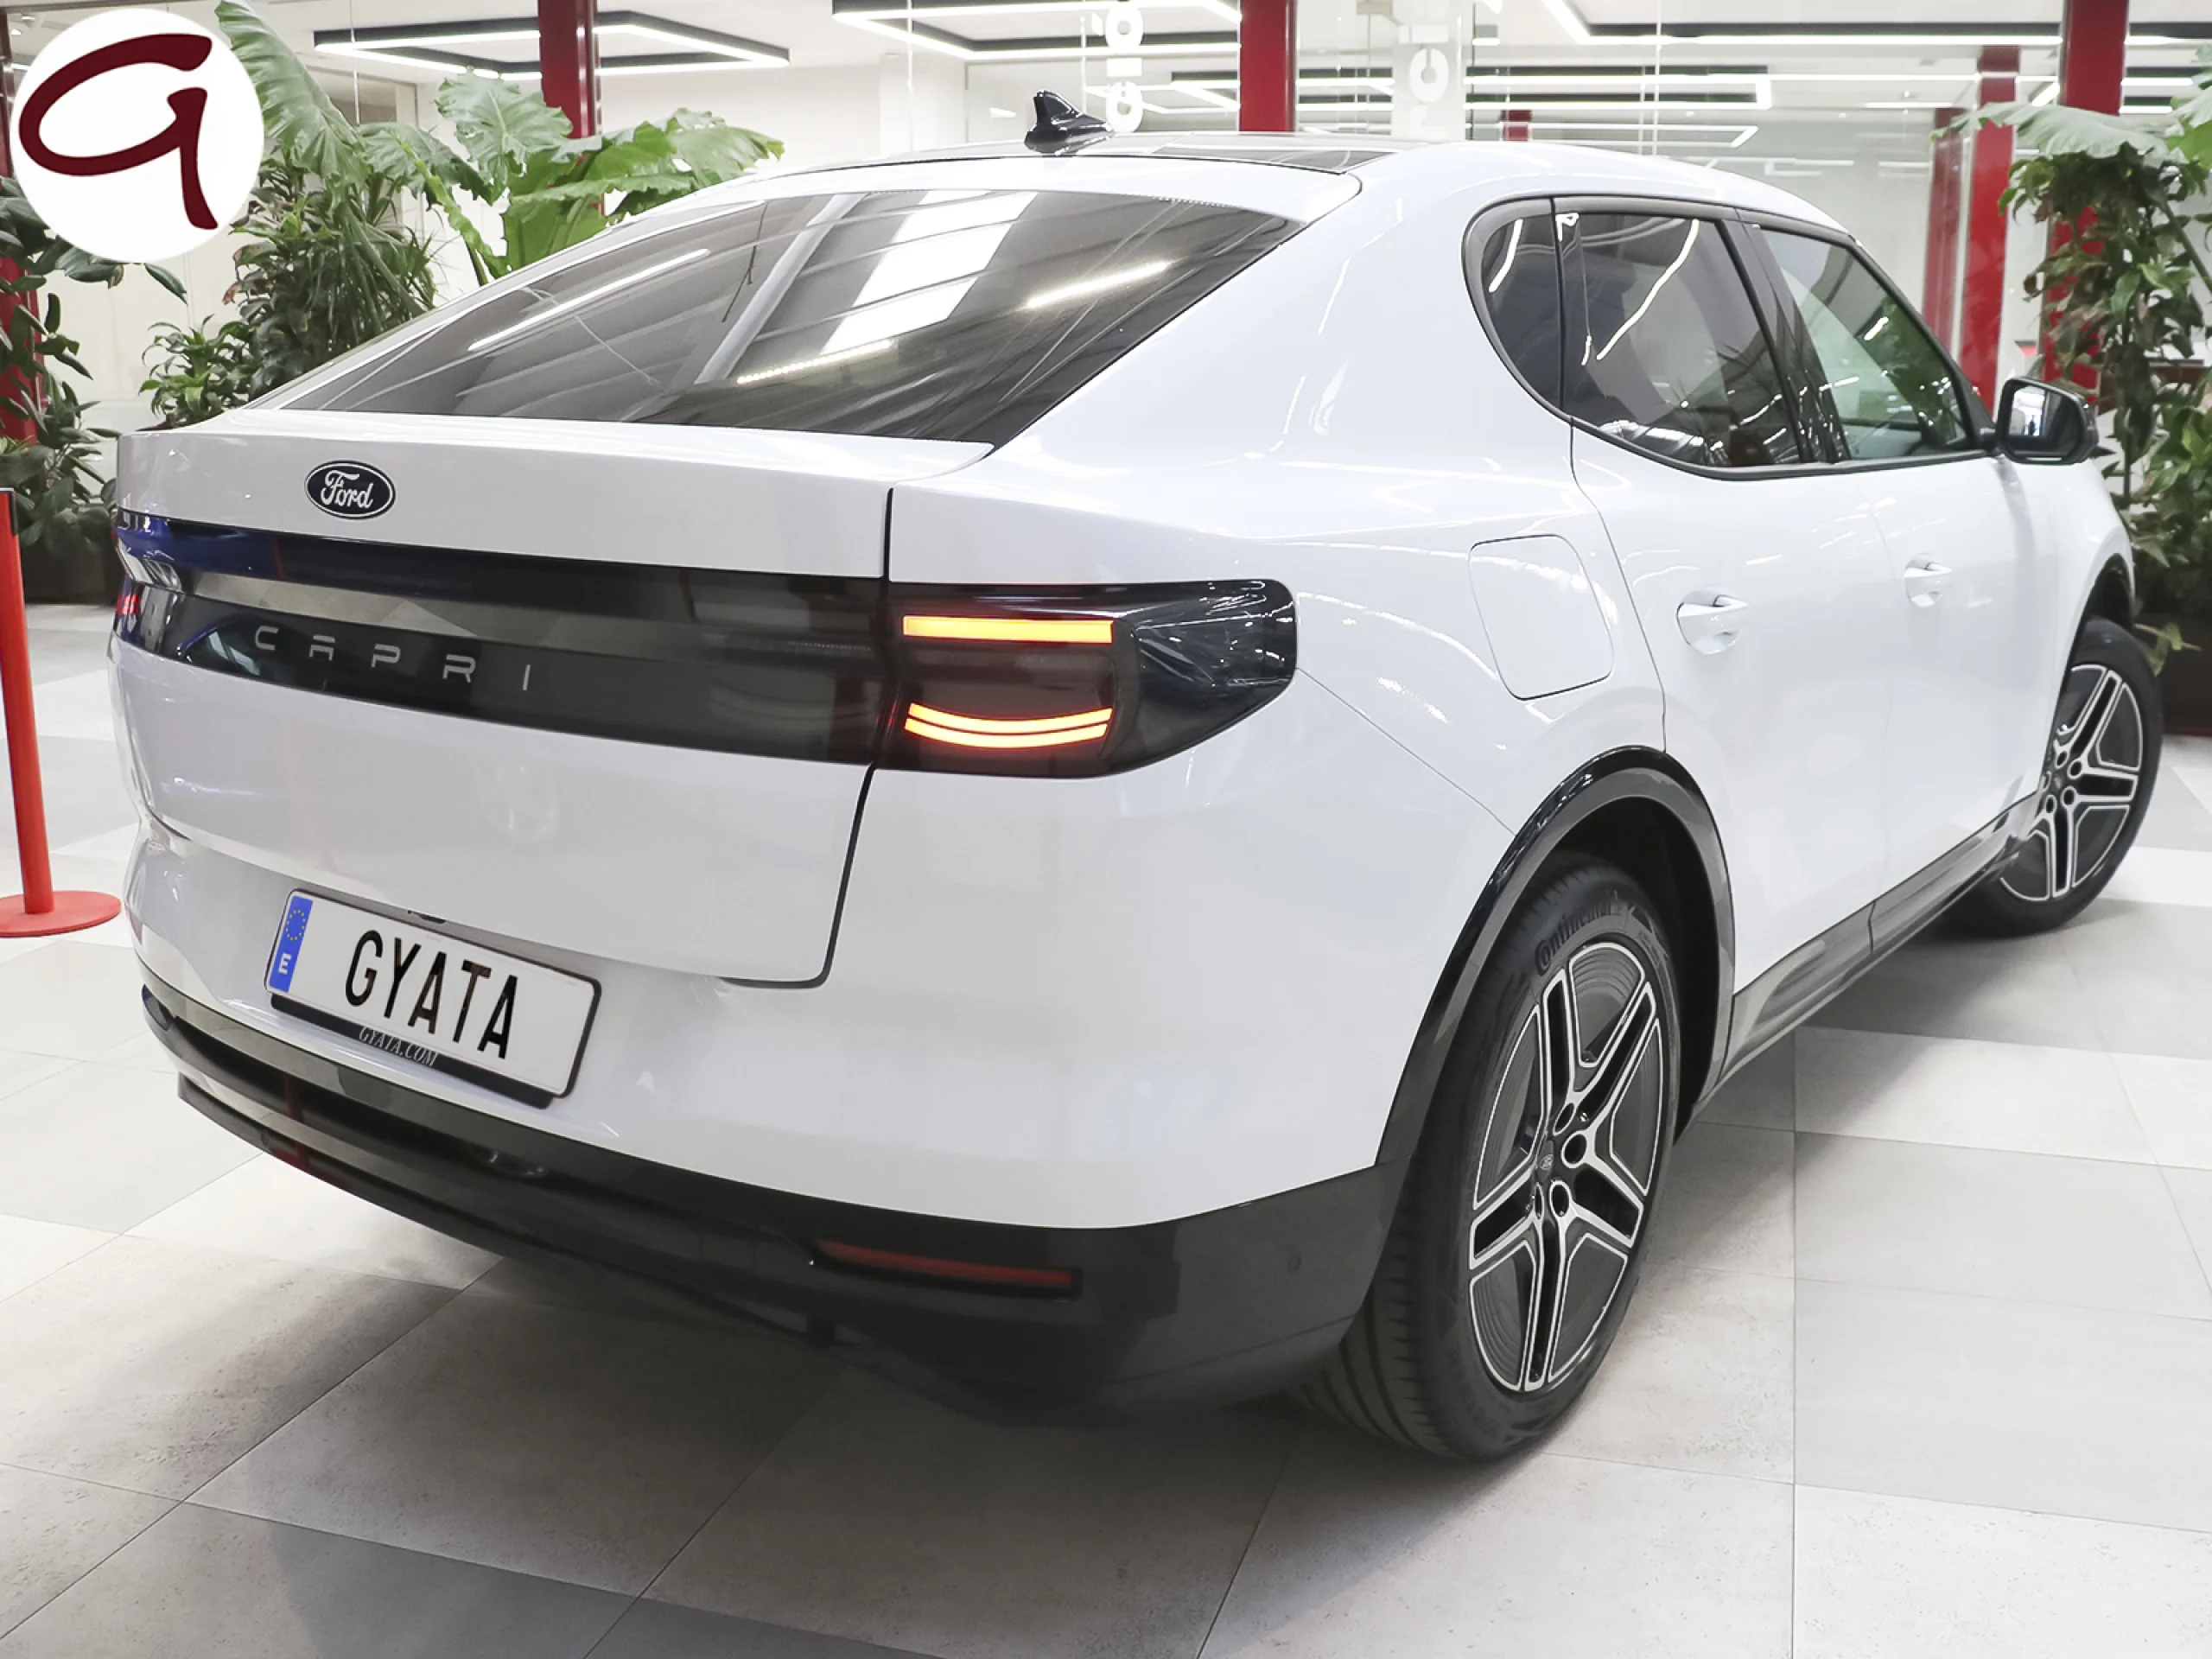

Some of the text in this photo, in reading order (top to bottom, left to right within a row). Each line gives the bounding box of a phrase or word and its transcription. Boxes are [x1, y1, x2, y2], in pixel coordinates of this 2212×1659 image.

[320, 469, 374, 509] Ford
[254, 625, 531, 691] CAPRI
[277, 953, 292, 976] E
[345, 929, 518, 1060] GYATA
[359, 1025, 438, 1067] GYATA.COM
